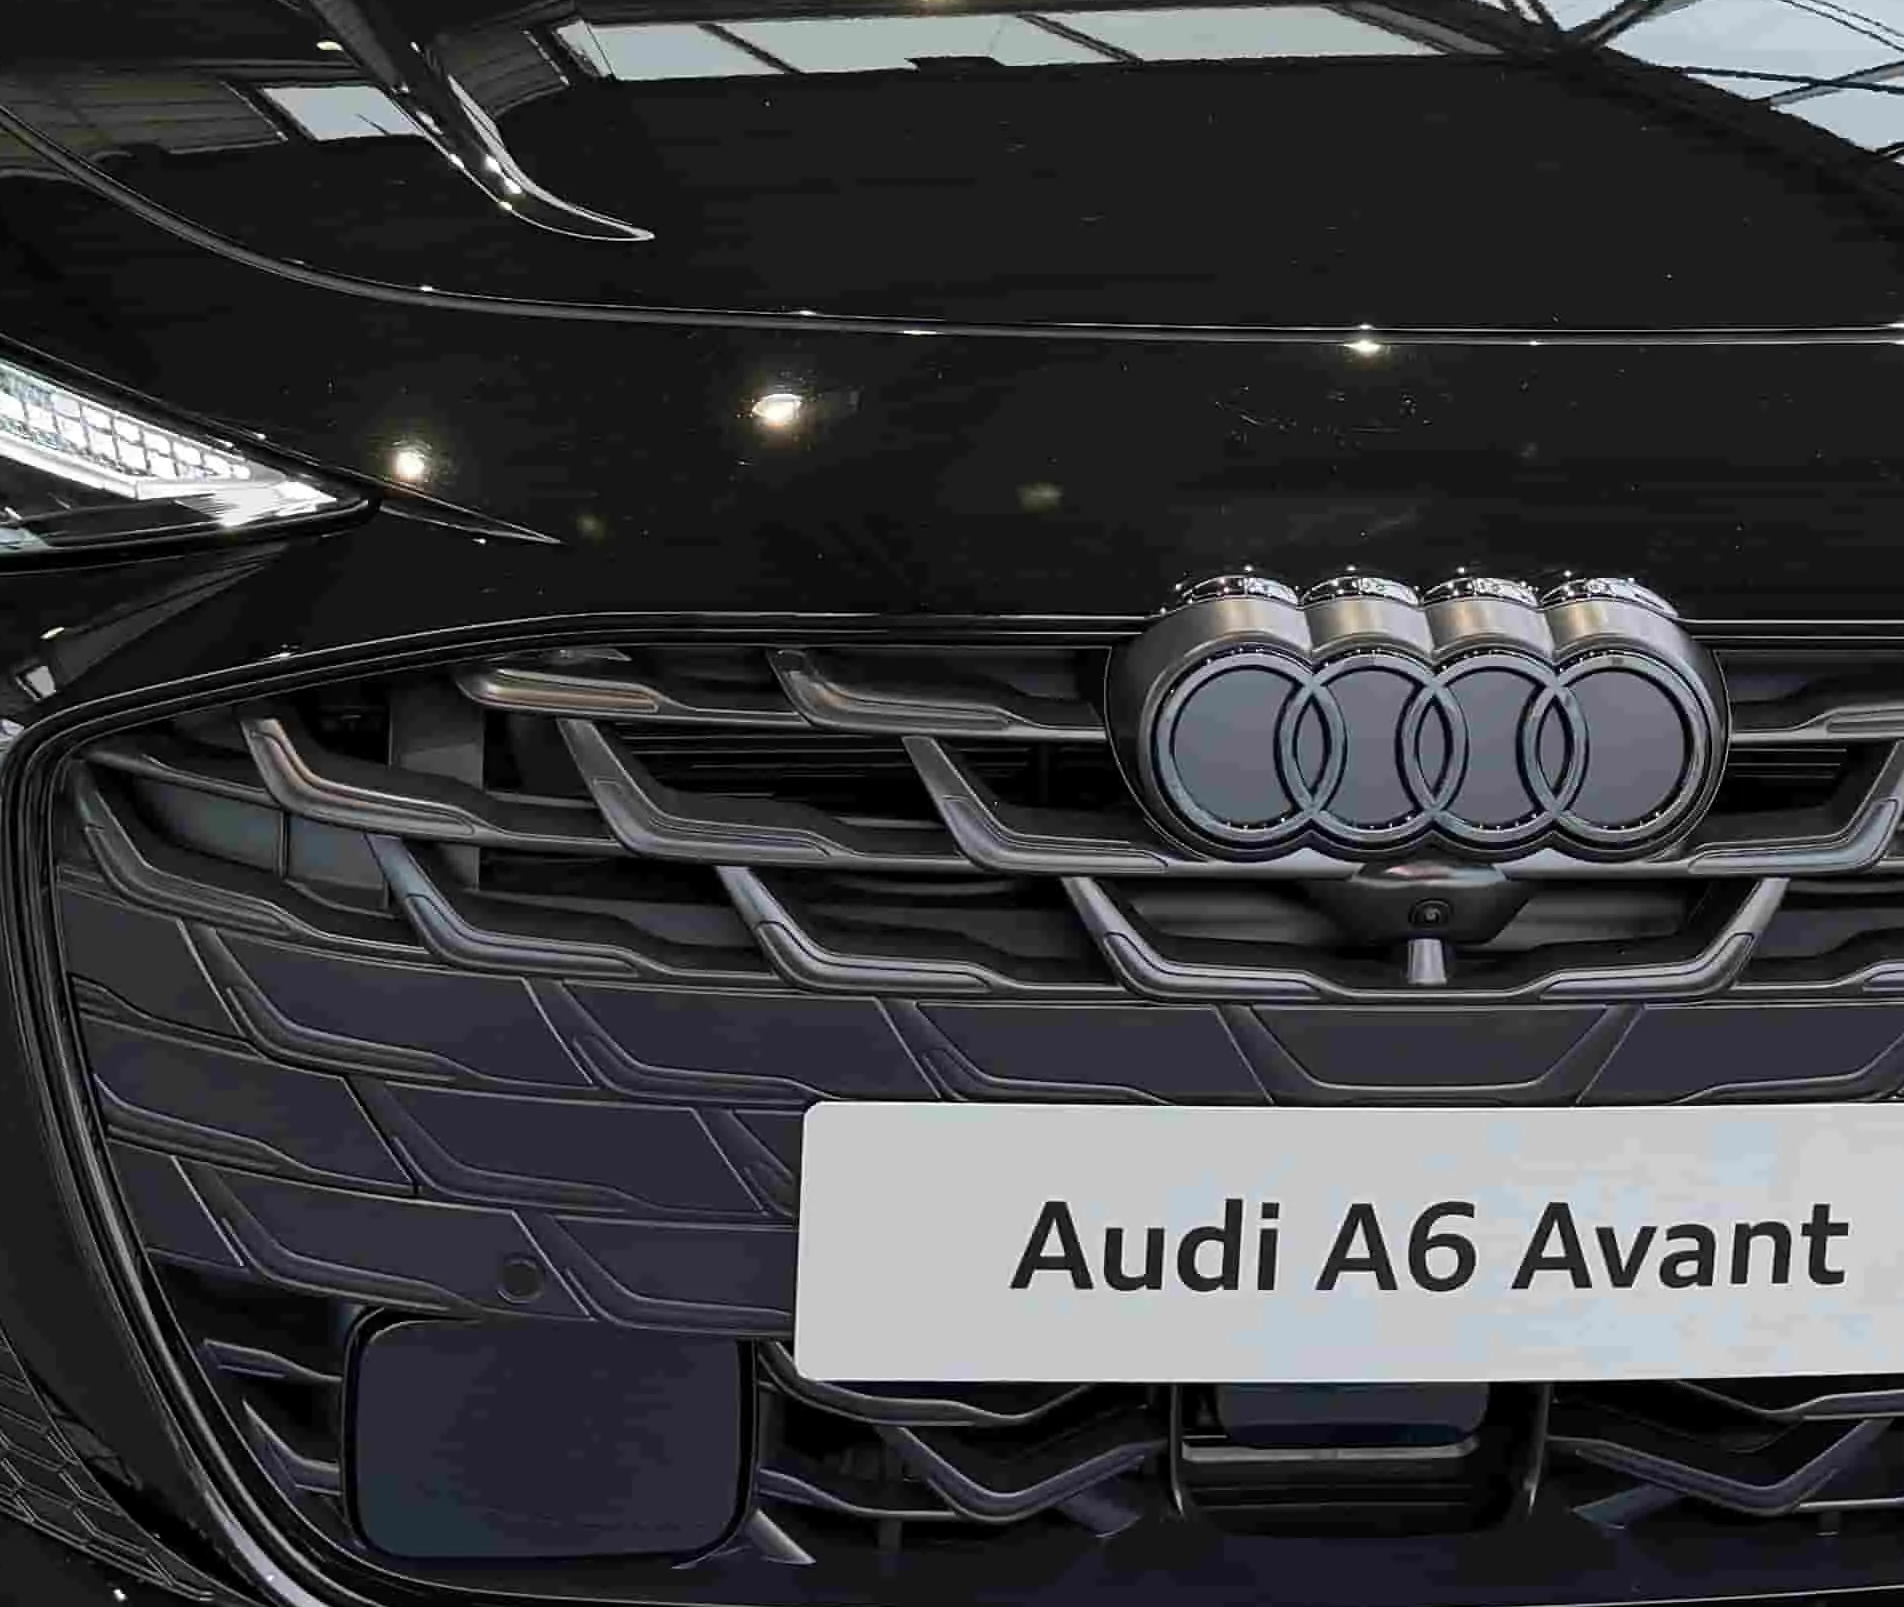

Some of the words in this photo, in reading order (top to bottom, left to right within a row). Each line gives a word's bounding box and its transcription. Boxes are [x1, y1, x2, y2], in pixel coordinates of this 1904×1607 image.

[1010, 1199, 1279, 1292] Audi
[1316, 1202, 1476, 1292] A6
[1512, 1202, 1848, 1289] Avant
